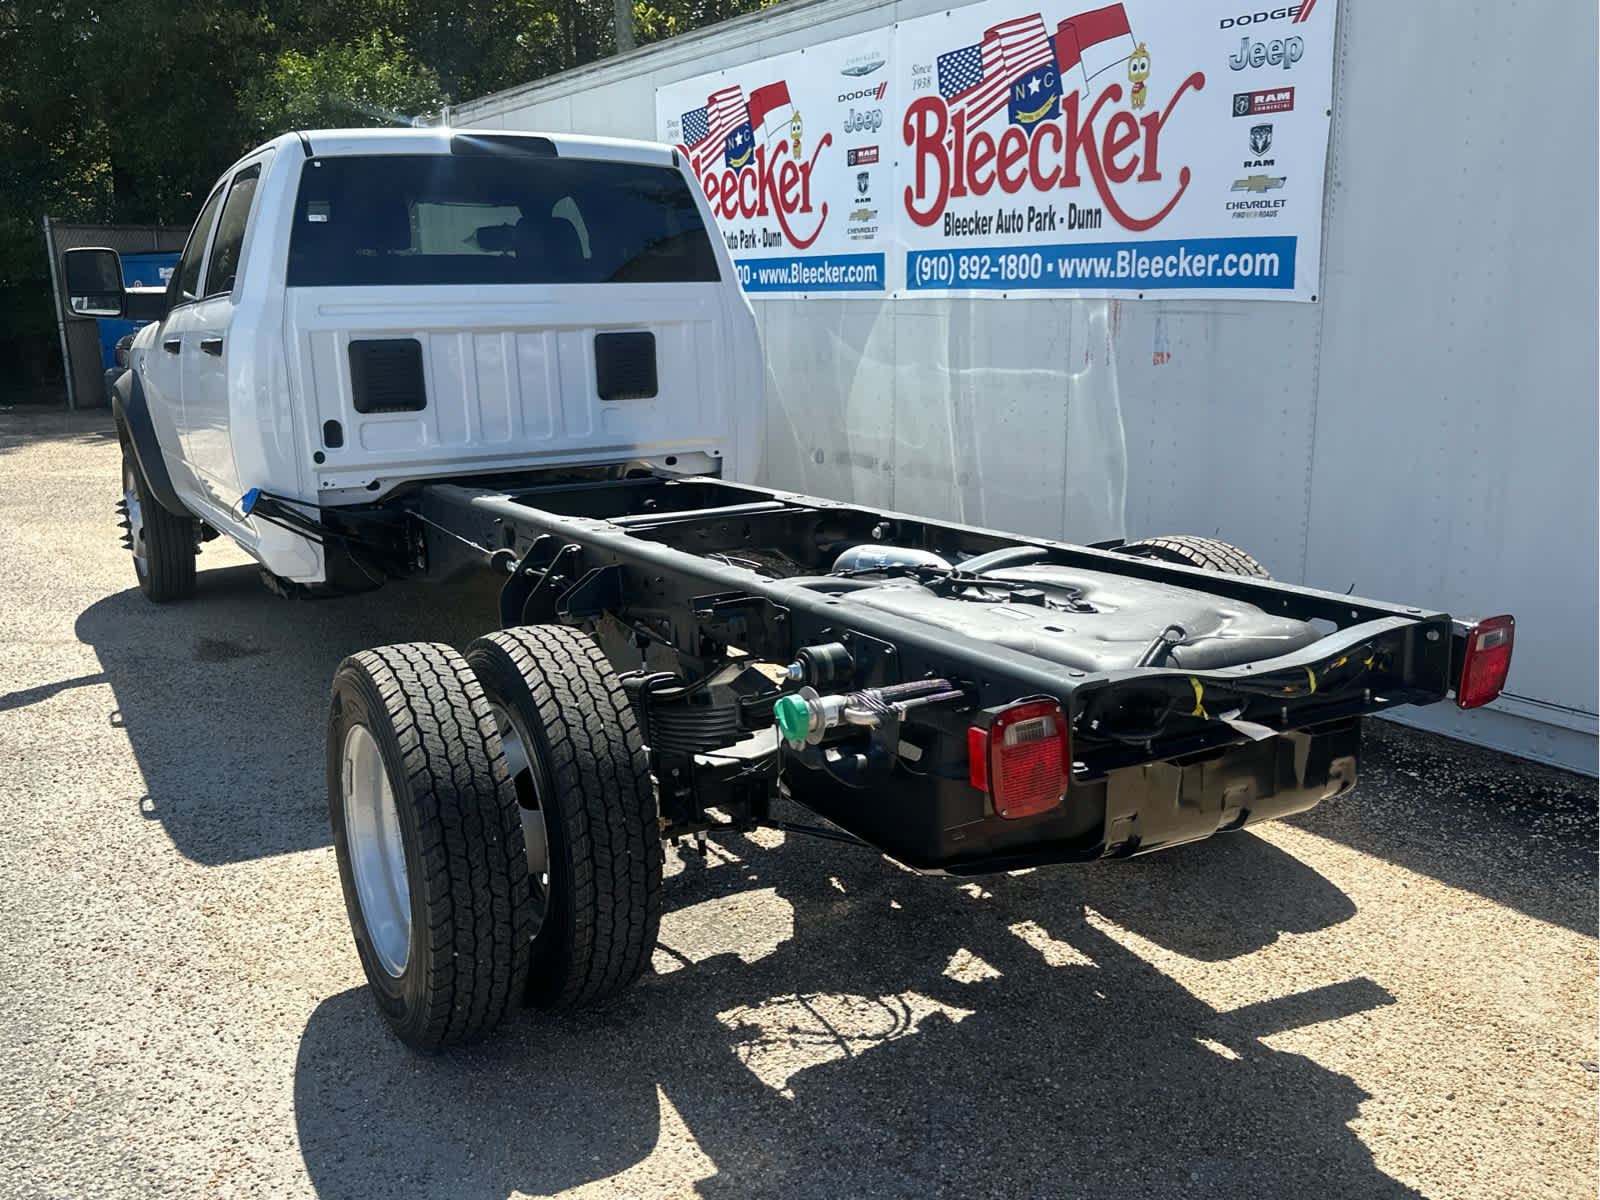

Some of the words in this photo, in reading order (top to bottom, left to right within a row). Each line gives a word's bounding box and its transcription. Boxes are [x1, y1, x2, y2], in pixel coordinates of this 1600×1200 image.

[1220, 5, 1303, 29] DODGE
[1228, 35, 1304, 71] Jeep
[837, 87, 880, 102] DODGE
[1254, 91, 1290, 104] RAM
[843, 108, 883, 133] Jeep
[903, 71, 1206, 232] Bleecker
[1243, 159, 1275, 168] RAM
[674, 132, 833, 250] eecker
[1225, 199, 1287, 210] CHEVROLET
[944, 211, 993, 237] Bleecker
[995, 208, 1023, 235] Auto
[1027, 204, 1056, 232] Park
[1068, 203, 1102, 230] Dunn
[740, 229, 757, 249] Park
[763, 227, 782, 248] Dunn
[758, 260, 878, 285] www.Bleecker.com
[915, 254, 955, 285] (910)
[958, 253, 1042, 280] 892-1800
[1058, 247, 1280, 279] www.Bleecker.com
